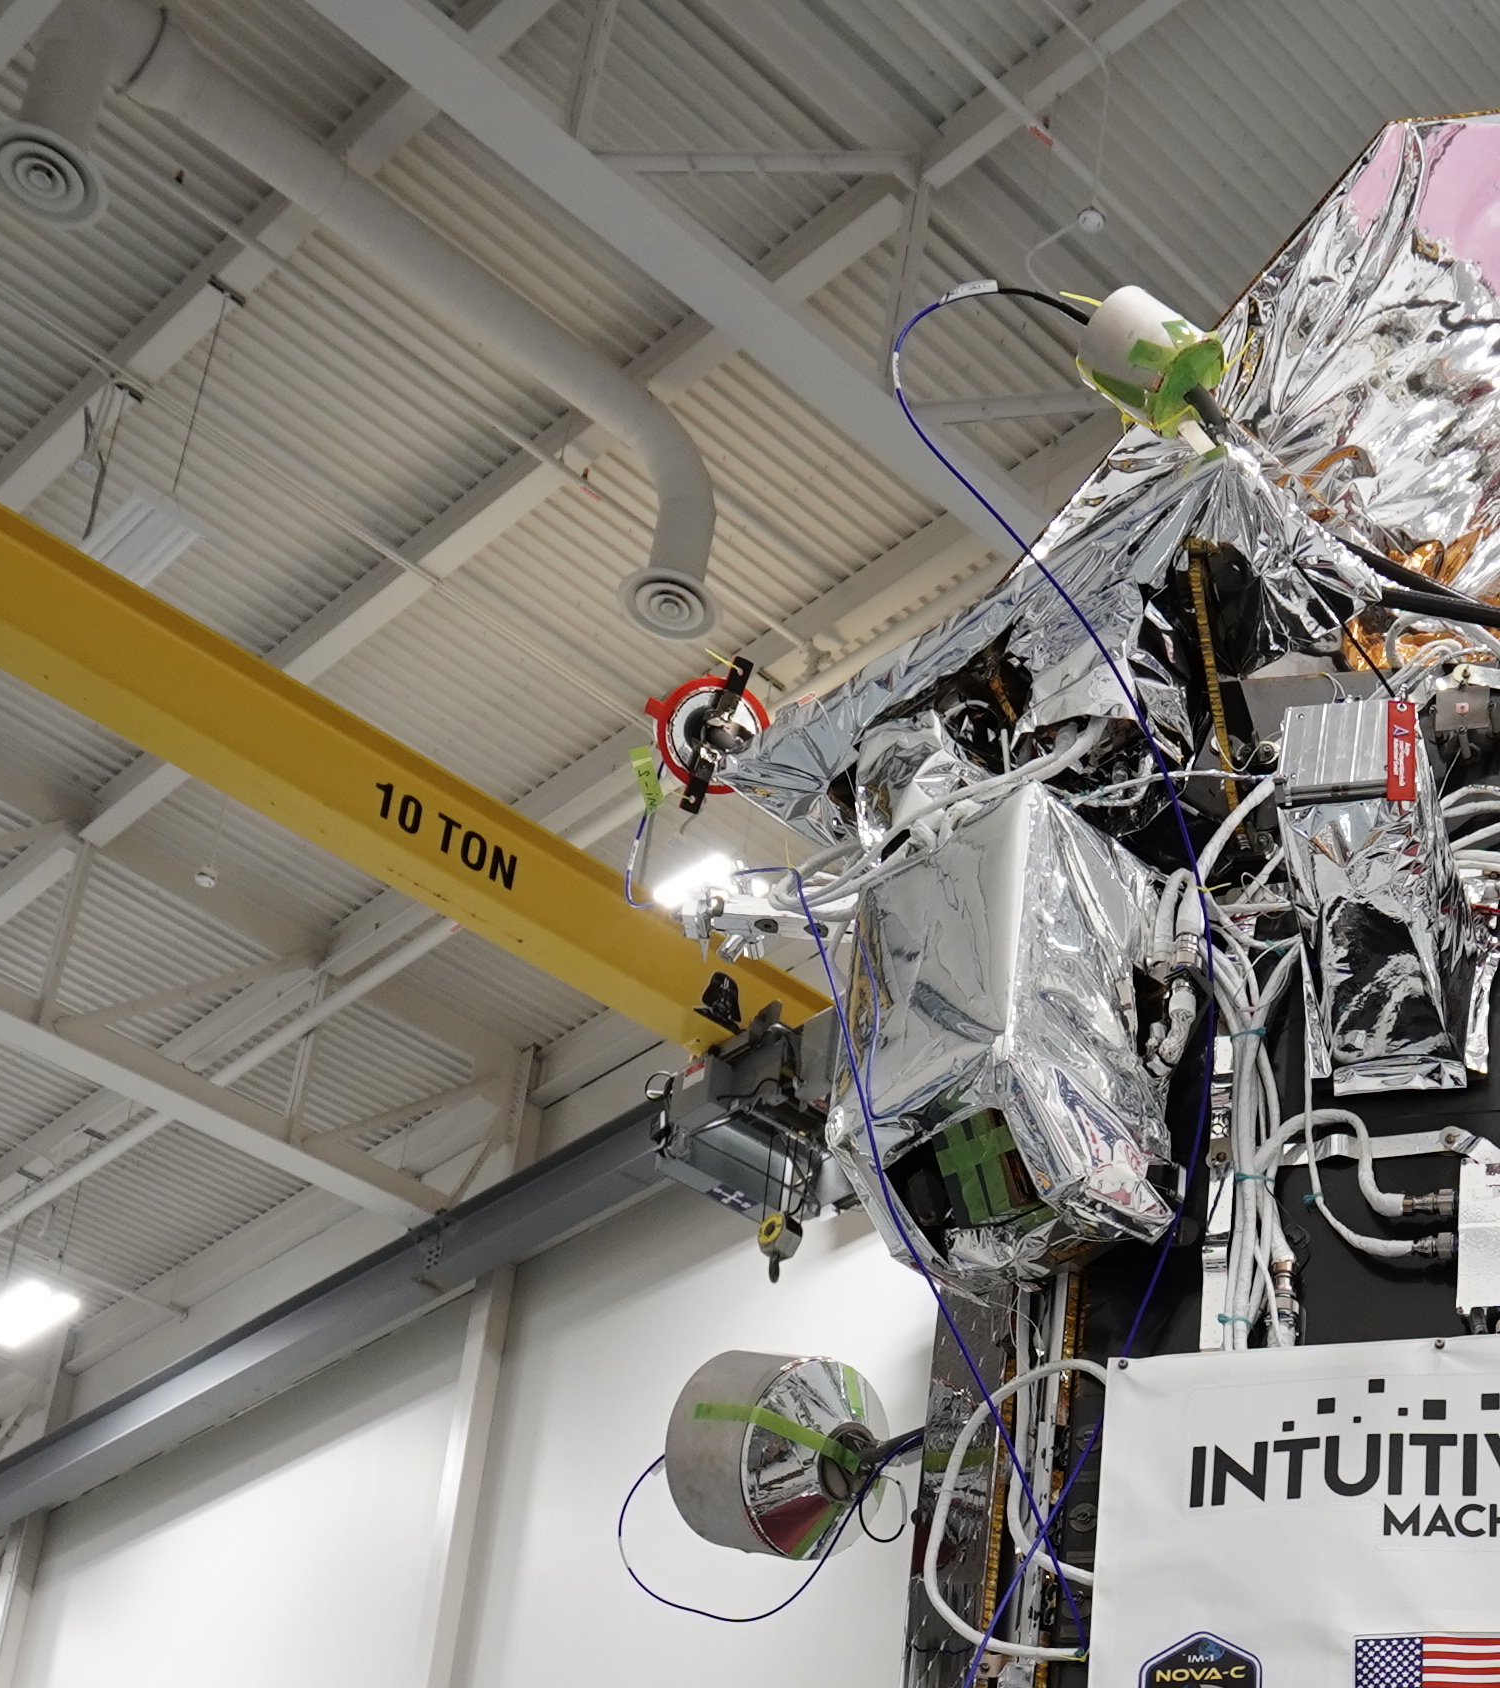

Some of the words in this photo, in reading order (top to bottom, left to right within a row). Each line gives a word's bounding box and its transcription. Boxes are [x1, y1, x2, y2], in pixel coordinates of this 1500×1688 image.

[375, 782, 423, 834] 10
[437, 812, 518, 891] TON
[1187, 1653, 1215, 1664] IM-1
[1155, 1665, 1247, 1683] NOVA-C
